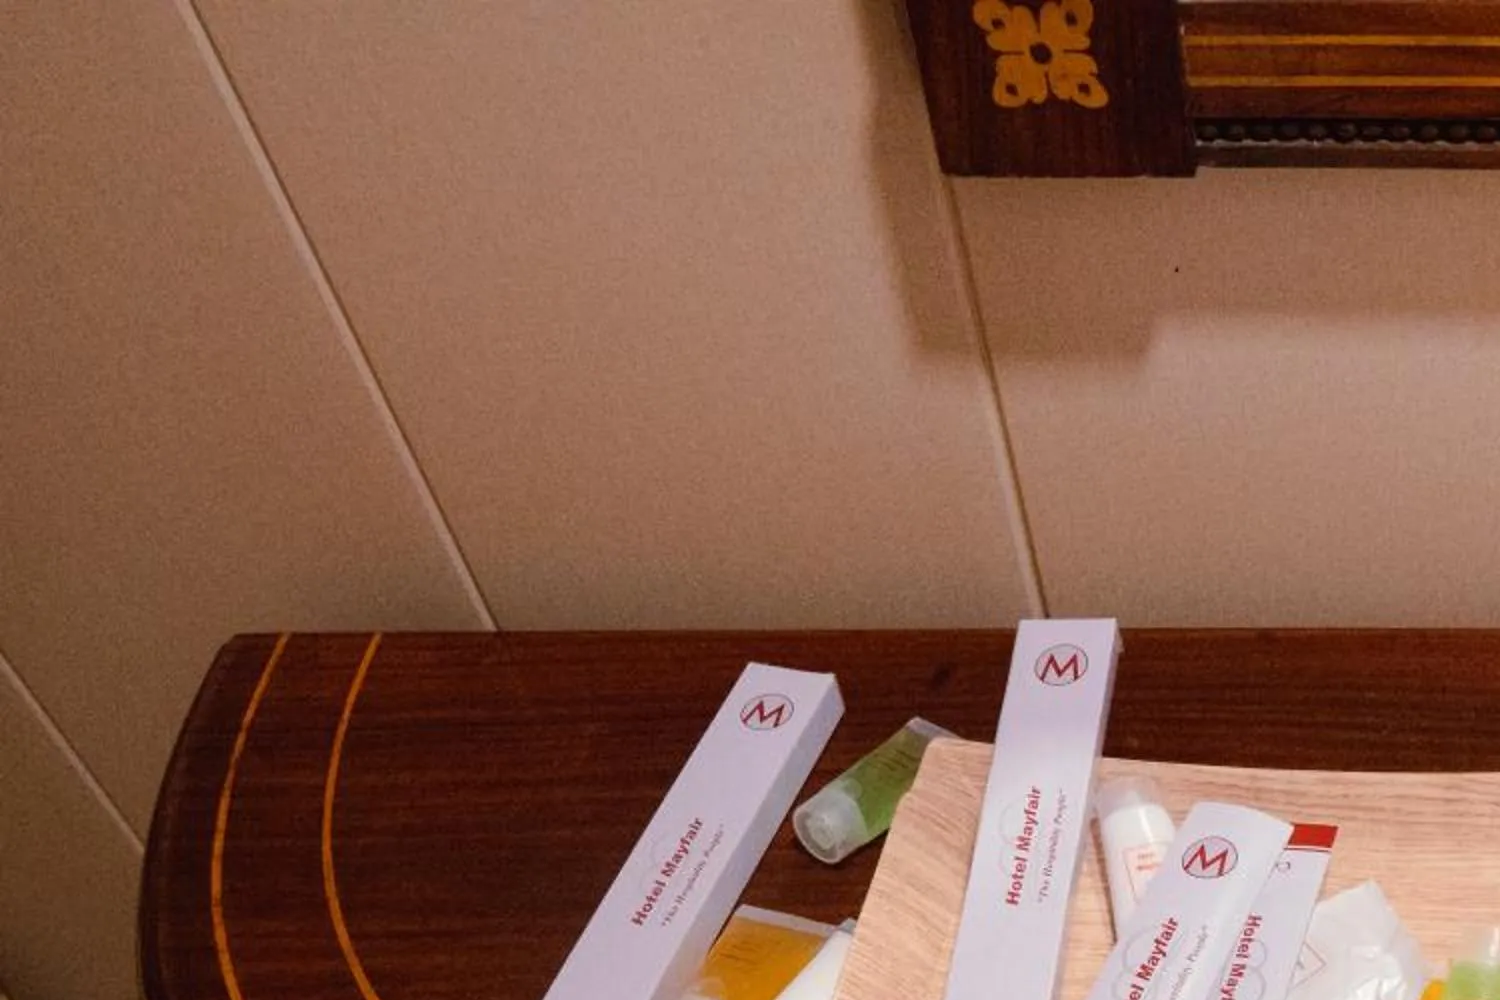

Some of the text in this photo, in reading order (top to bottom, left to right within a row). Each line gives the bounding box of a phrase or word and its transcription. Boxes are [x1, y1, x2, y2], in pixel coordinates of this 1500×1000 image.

[1040, 653, 1079, 682] M
[741, 700, 785, 728] M
[1005, 786, 1041, 906] Hotel Mayfair
[1183, 843, 1229, 877] M
[631, 817, 703, 926] Hotel Mayfair
[1135, 916, 1179, 981] Mayfair
[1235, 914, 1263, 959] Hotel
